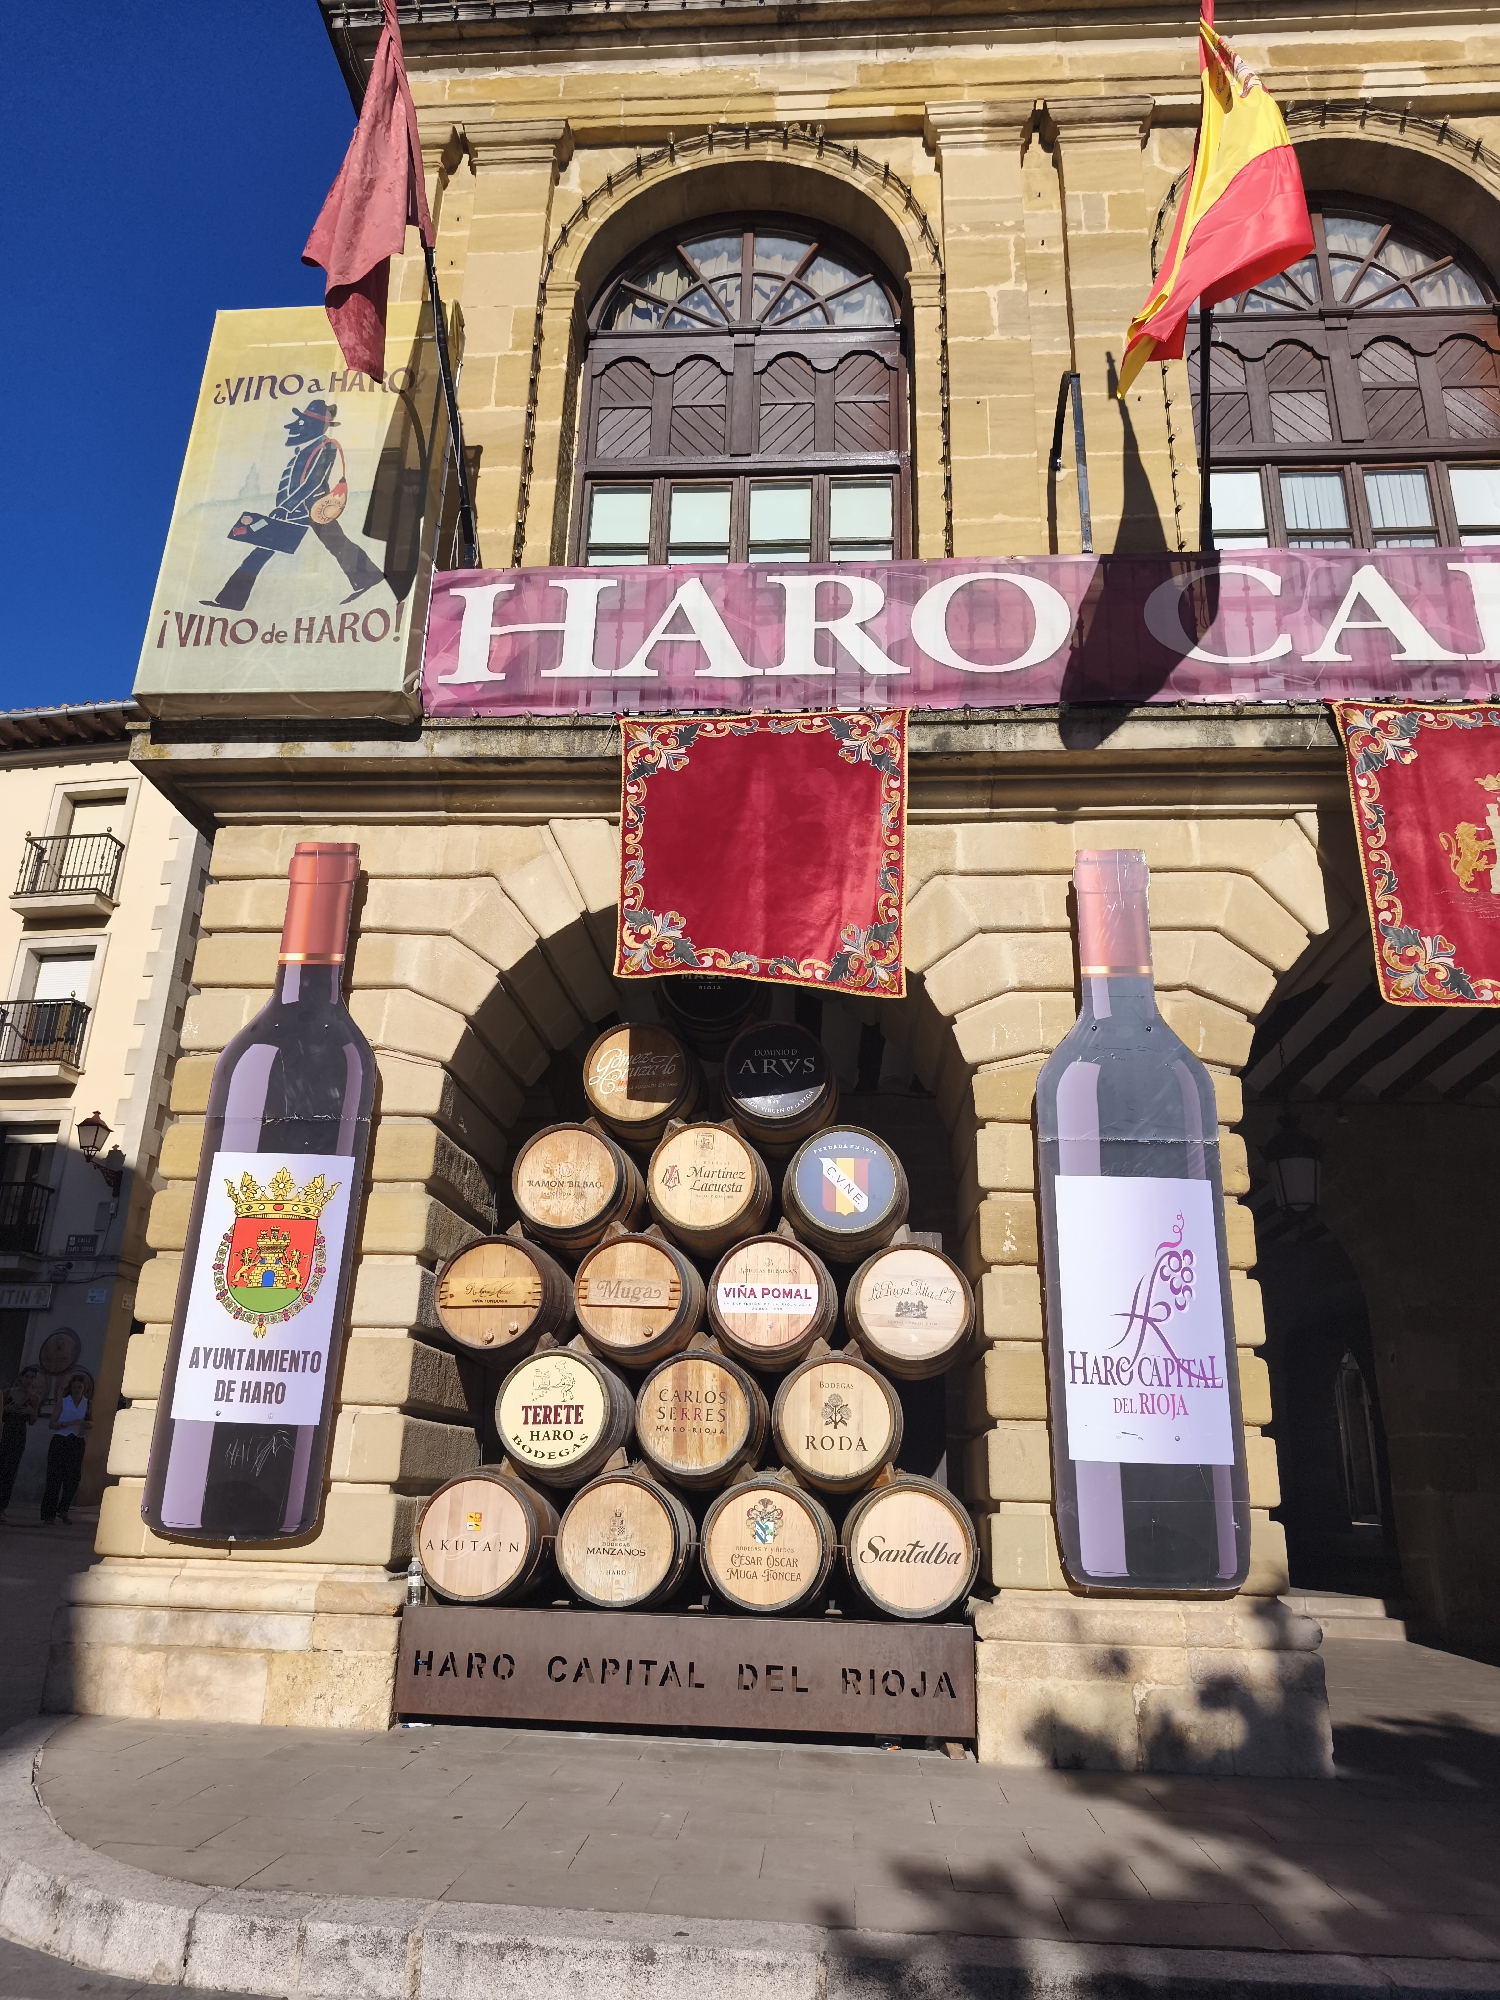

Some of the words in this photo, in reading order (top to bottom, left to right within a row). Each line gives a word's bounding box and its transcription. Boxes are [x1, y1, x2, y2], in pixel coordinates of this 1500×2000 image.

[213, 374, 304, 406] ¿VINO
[307, 379, 325, 393] a
[157, 610, 258, 648] ¡VINO
[261, 623, 288, 644] de
[294, 601, 405, 644] HARO!
[438, 572, 1071, 684] HARO
[737, 1056, 816, 1077] ARVS
[686, 1165, 746, 1180] Martínez
[566, 1180, 602, 1189] BILBAO
[689, 1179, 743, 1193] Lacuesta
[596, 1279, 662, 1303] Muga
[723, 1284, 758, 1299] VIÑA
[761, 1287, 812, 1300] POMAL
[188, 1346, 323, 1374] AYUNTAMIENTO
[1068, 1350, 1134, 1386] HARO
[1137, 1355, 1224, 1389] CAPITAL
[213, 1379, 237, 1403] DE
[239, 1380, 287, 1405] HARO
[819, 1381, 854, 1390] BODEGAS
[659, 1388, 727, 1405] CARLOS
[1113, 1397, 1138, 1414] DEL
[1138, 1392, 1190, 1421] RIOJA
[521, 1404, 584, 1425] TERETE
[657, 1406, 726, 1423] SERRES
[529, 1429, 574, 1441] HARO
[805, 1434, 868, 1452] RODA
[512, 1433, 589, 1460] BODEGAS
[425, 1539, 520, 1553] AKUTAIN
[586, 1547, 647, 1557] MANZANOS
[859, 1535, 962, 1565] Santalba
[726, 1567, 758, 1581] MUGA
[761, 1568, 802, 1583] FONCEA
[412, 1649, 516, 1681] HARO
[546, 1655, 706, 1689] CAPITAL
[737, 1662, 809, 1694] DEL
[841, 1667, 957, 1700] RIOJA
